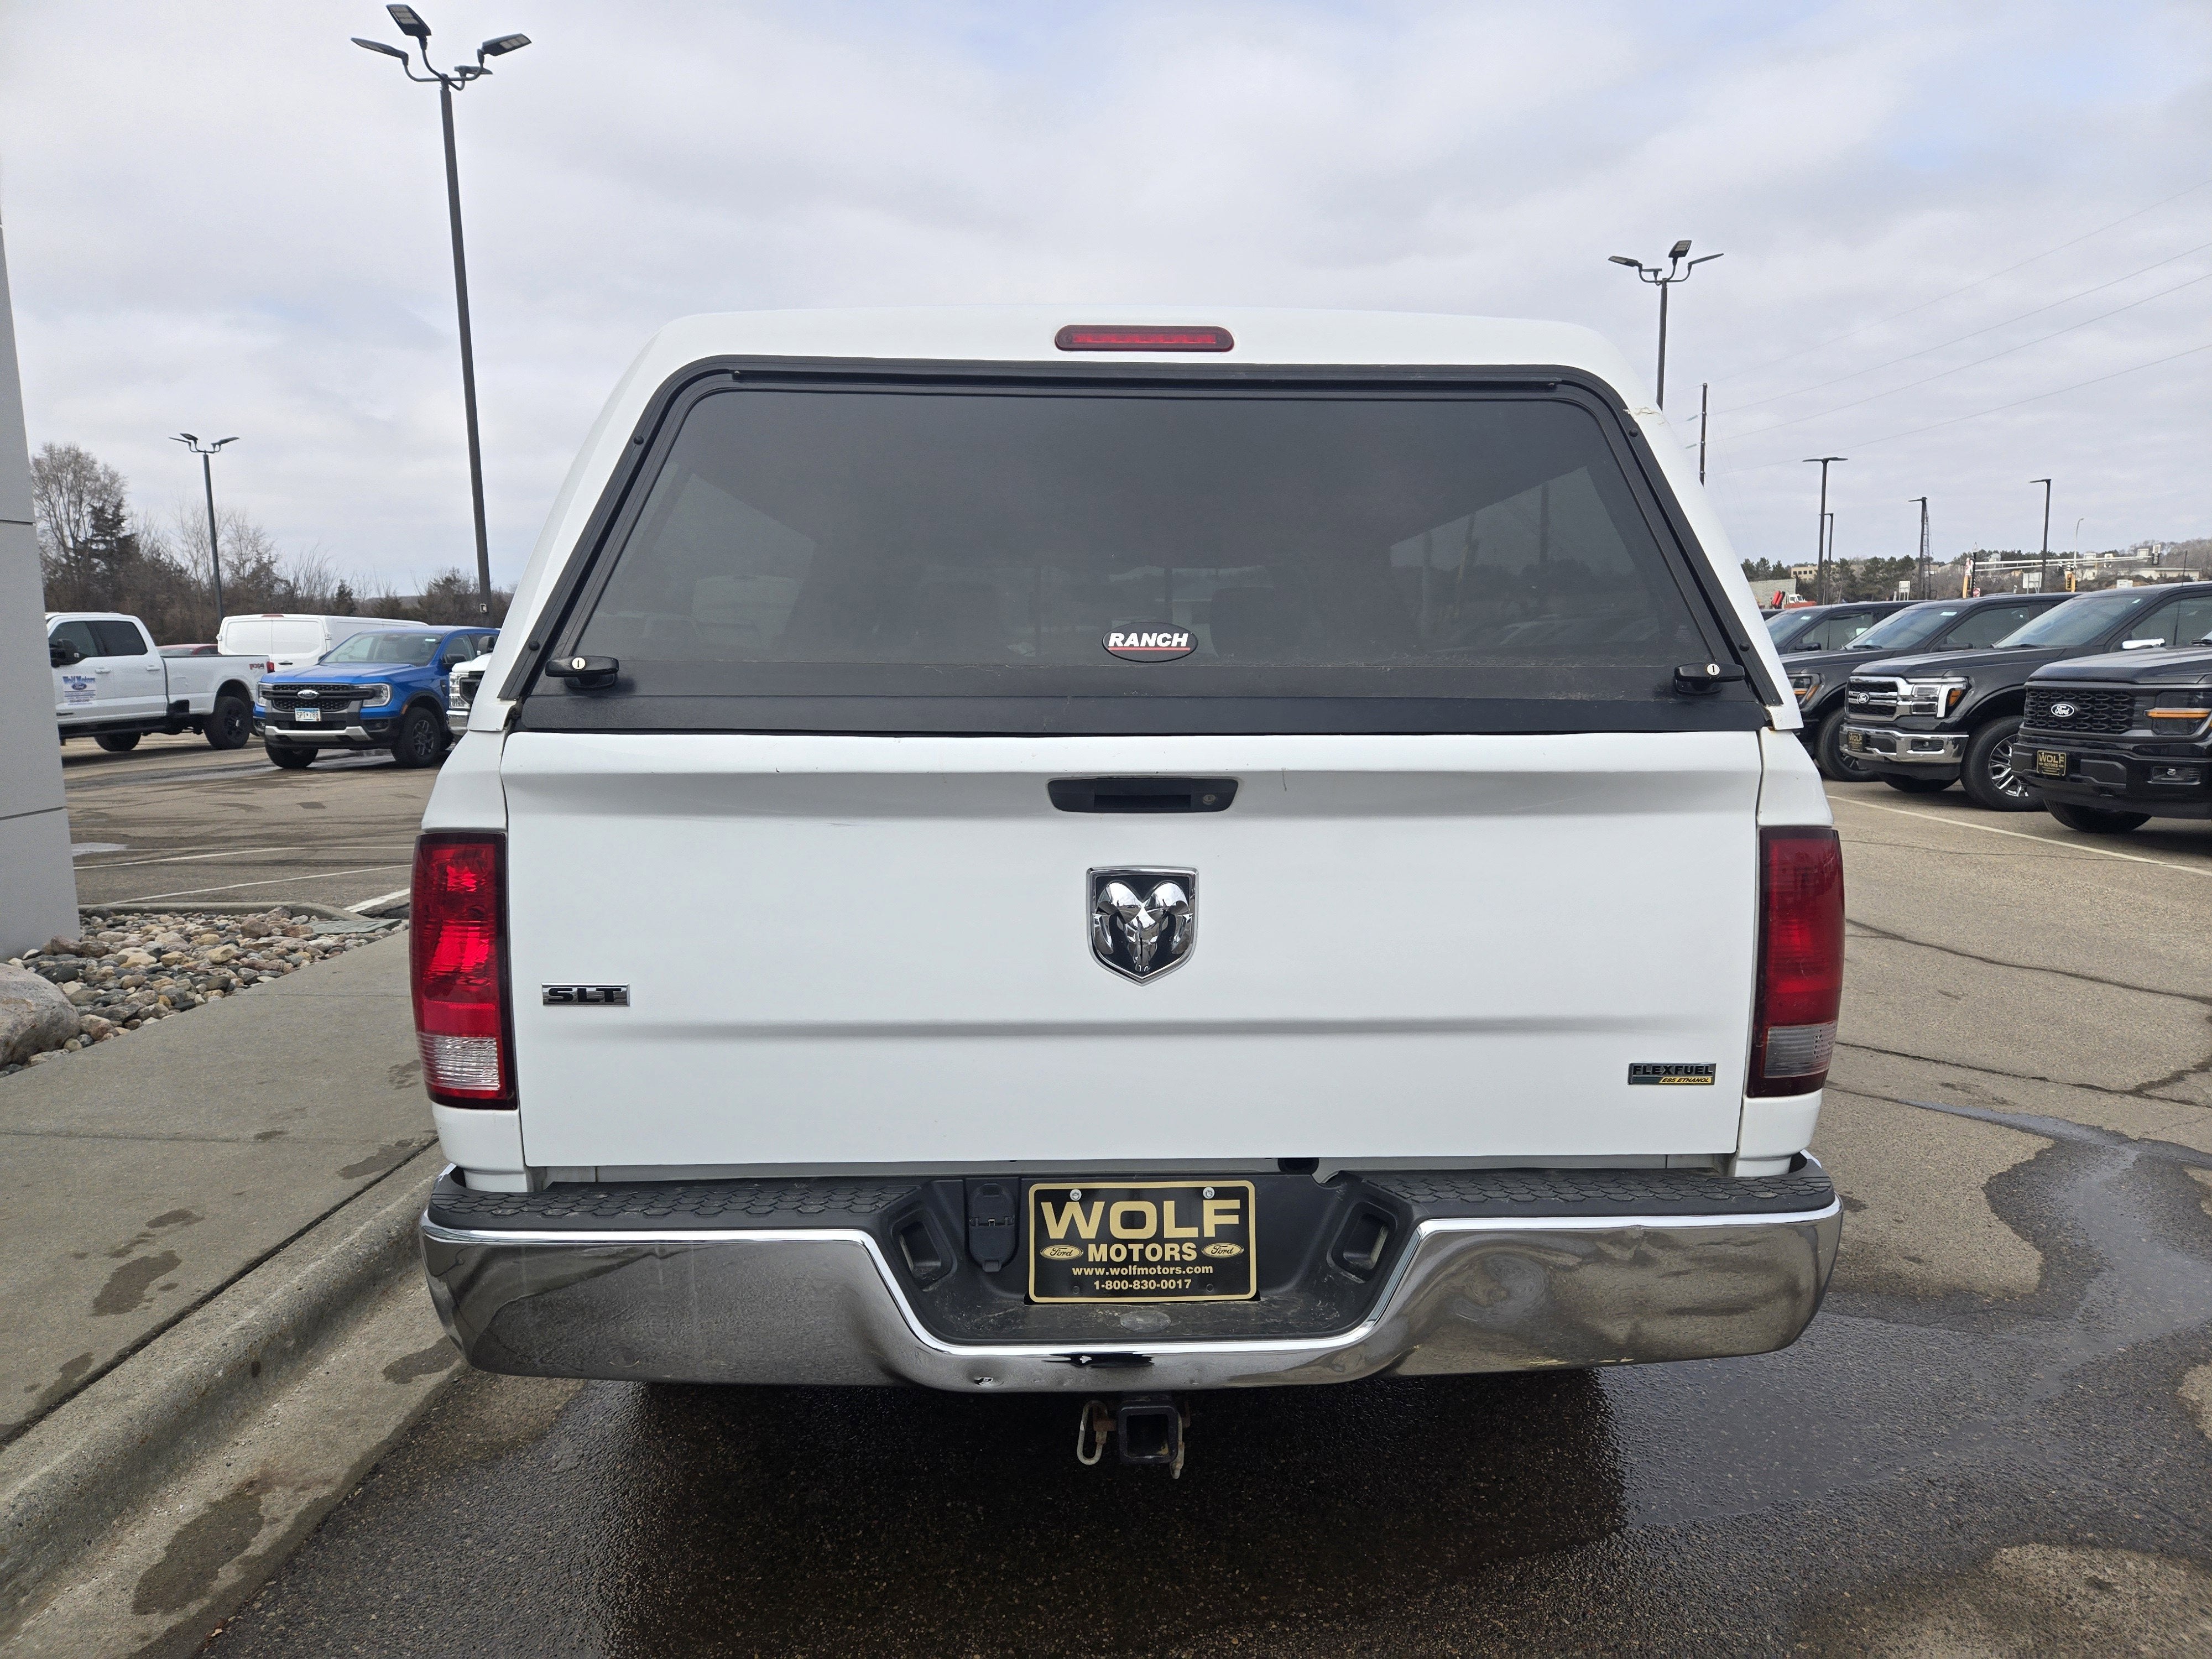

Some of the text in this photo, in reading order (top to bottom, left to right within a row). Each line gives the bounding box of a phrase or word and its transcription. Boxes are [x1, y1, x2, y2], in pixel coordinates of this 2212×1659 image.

[1108, 633, 1189, 647] RANCH
[2038, 754, 2064, 764] WOLF
[548, 988, 622, 1003] SLT
[1040, 1199, 1240, 1239] WOLF
[1088, 1242, 1197, 1262] MOTORS
[1072, 1265, 1213, 1275] www.wolfmotors.com
[1093, 1279, 1192, 1290] 1-800-830-0017
